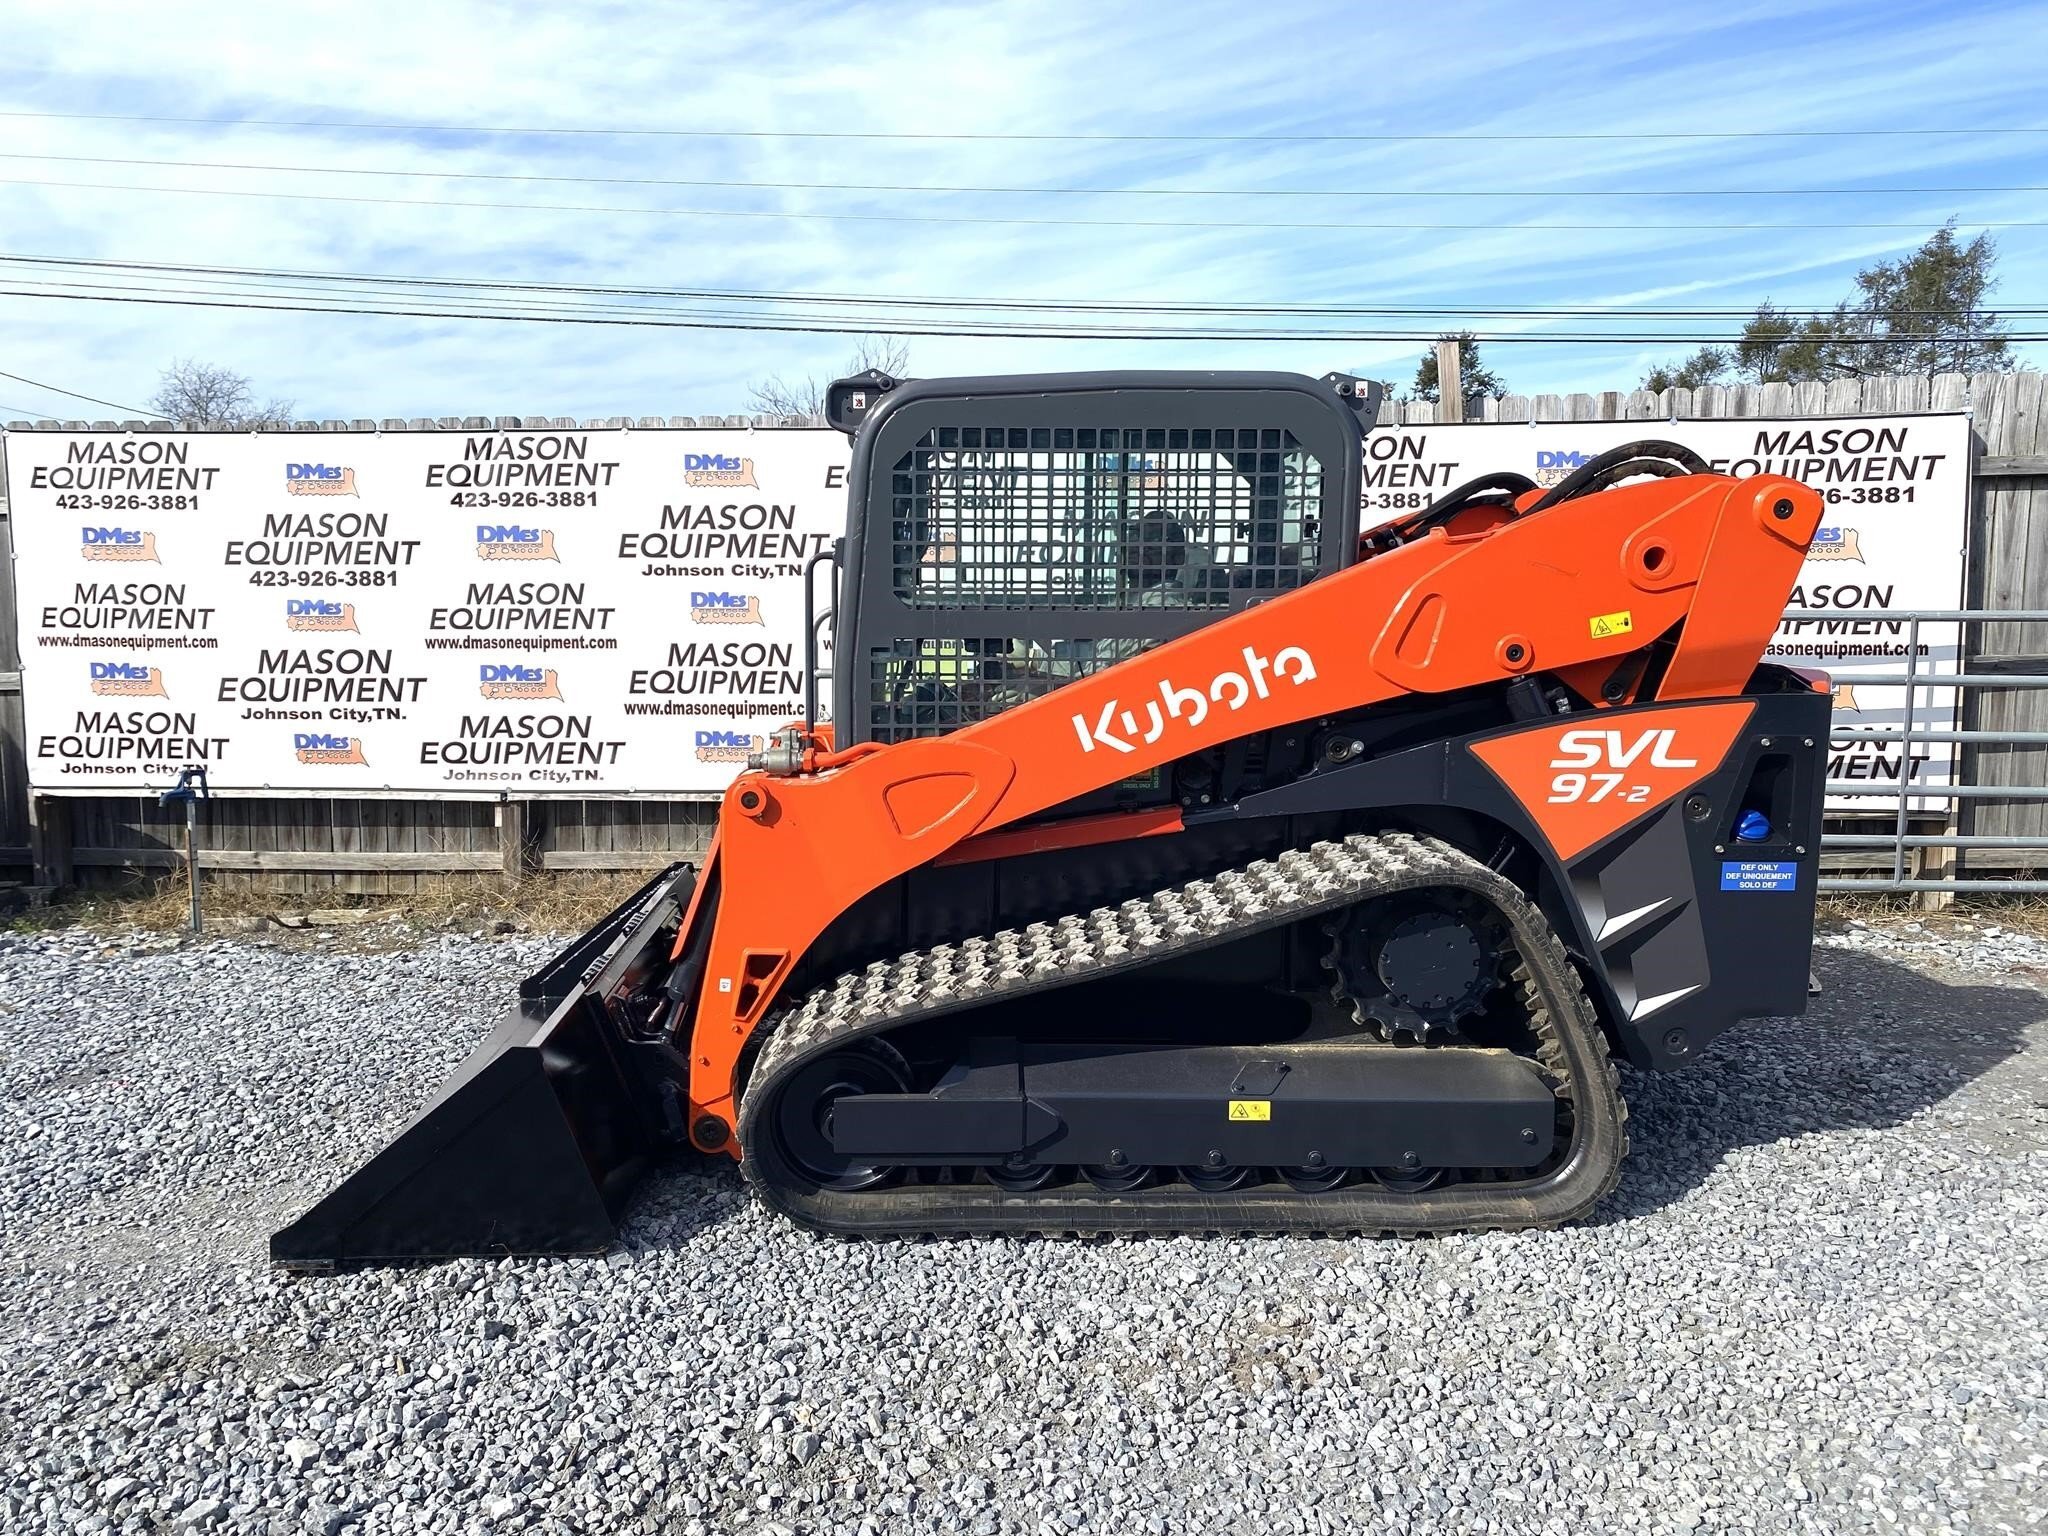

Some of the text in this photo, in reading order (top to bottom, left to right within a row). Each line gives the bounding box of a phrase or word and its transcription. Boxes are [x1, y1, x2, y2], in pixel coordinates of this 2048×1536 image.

[464, 437, 587, 460] MASON
[1754, 428, 1908, 455] MASON
[68, 442, 188, 464] MASON
[31, 467, 220, 490] EQUIPMENT
[426, 463, 619, 487] EQUIPMENT
[1708, 454, 1946, 483] EQUIPMENT
[56, 495, 197, 510] 423-926-3881
[451, 492, 596, 507] 423-926-3881
[1360, 492, 1432, 509] 6-3881
[1827, 487, 1914, 504] 6-3881
[264, 513, 388, 537] MASON
[660, 505, 795, 530] MASON
[225, 541, 420, 565] EQUIPMENT
[618, 533, 831, 558] EQUIPMENT
[250, 571, 396, 586] 423-926-3881
[642, 564, 724, 576] Johnson
[75, 584, 185, 605] MASON
[467, 583, 584, 605] MASON
[1785, 584, 1893, 608] ASON
[42, 607, 215, 629] EQUIPMENT
[430, 608, 615, 630] EQUIPMENT
[38, 634, 218, 651] www.dmasonequipment.com
[425, 635, 617, 651] www.dmasonequipment.com
[1766, 641, 1928, 659] asonequipment.cm
[258, 649, 392, 674] MASON
[668, 643, 792, 667] MASON
[218, 677, 427, 702] EQUIPMENT
[629, 671, 803, 694] EQUIPMEN
[624, 702, 804, 718] www.dmasonequipment.c
[1072, 646, 1317, 753] Kubota
[75, 712, 195, 734] MASON
[241, 708, 322, 719] Johnson
[460, 715, 591, 738] MASON
[38, 736, 229, 759] EQUIPMENT
[421, 742, 626, 764] EQUIPMENT
[1550, 730, 1697, 768] SVL
[61, 763, 136, 773] Johnson
[444, 770, 521, 780] Johnson
[1547, 774, 1651, 803] 97-2
